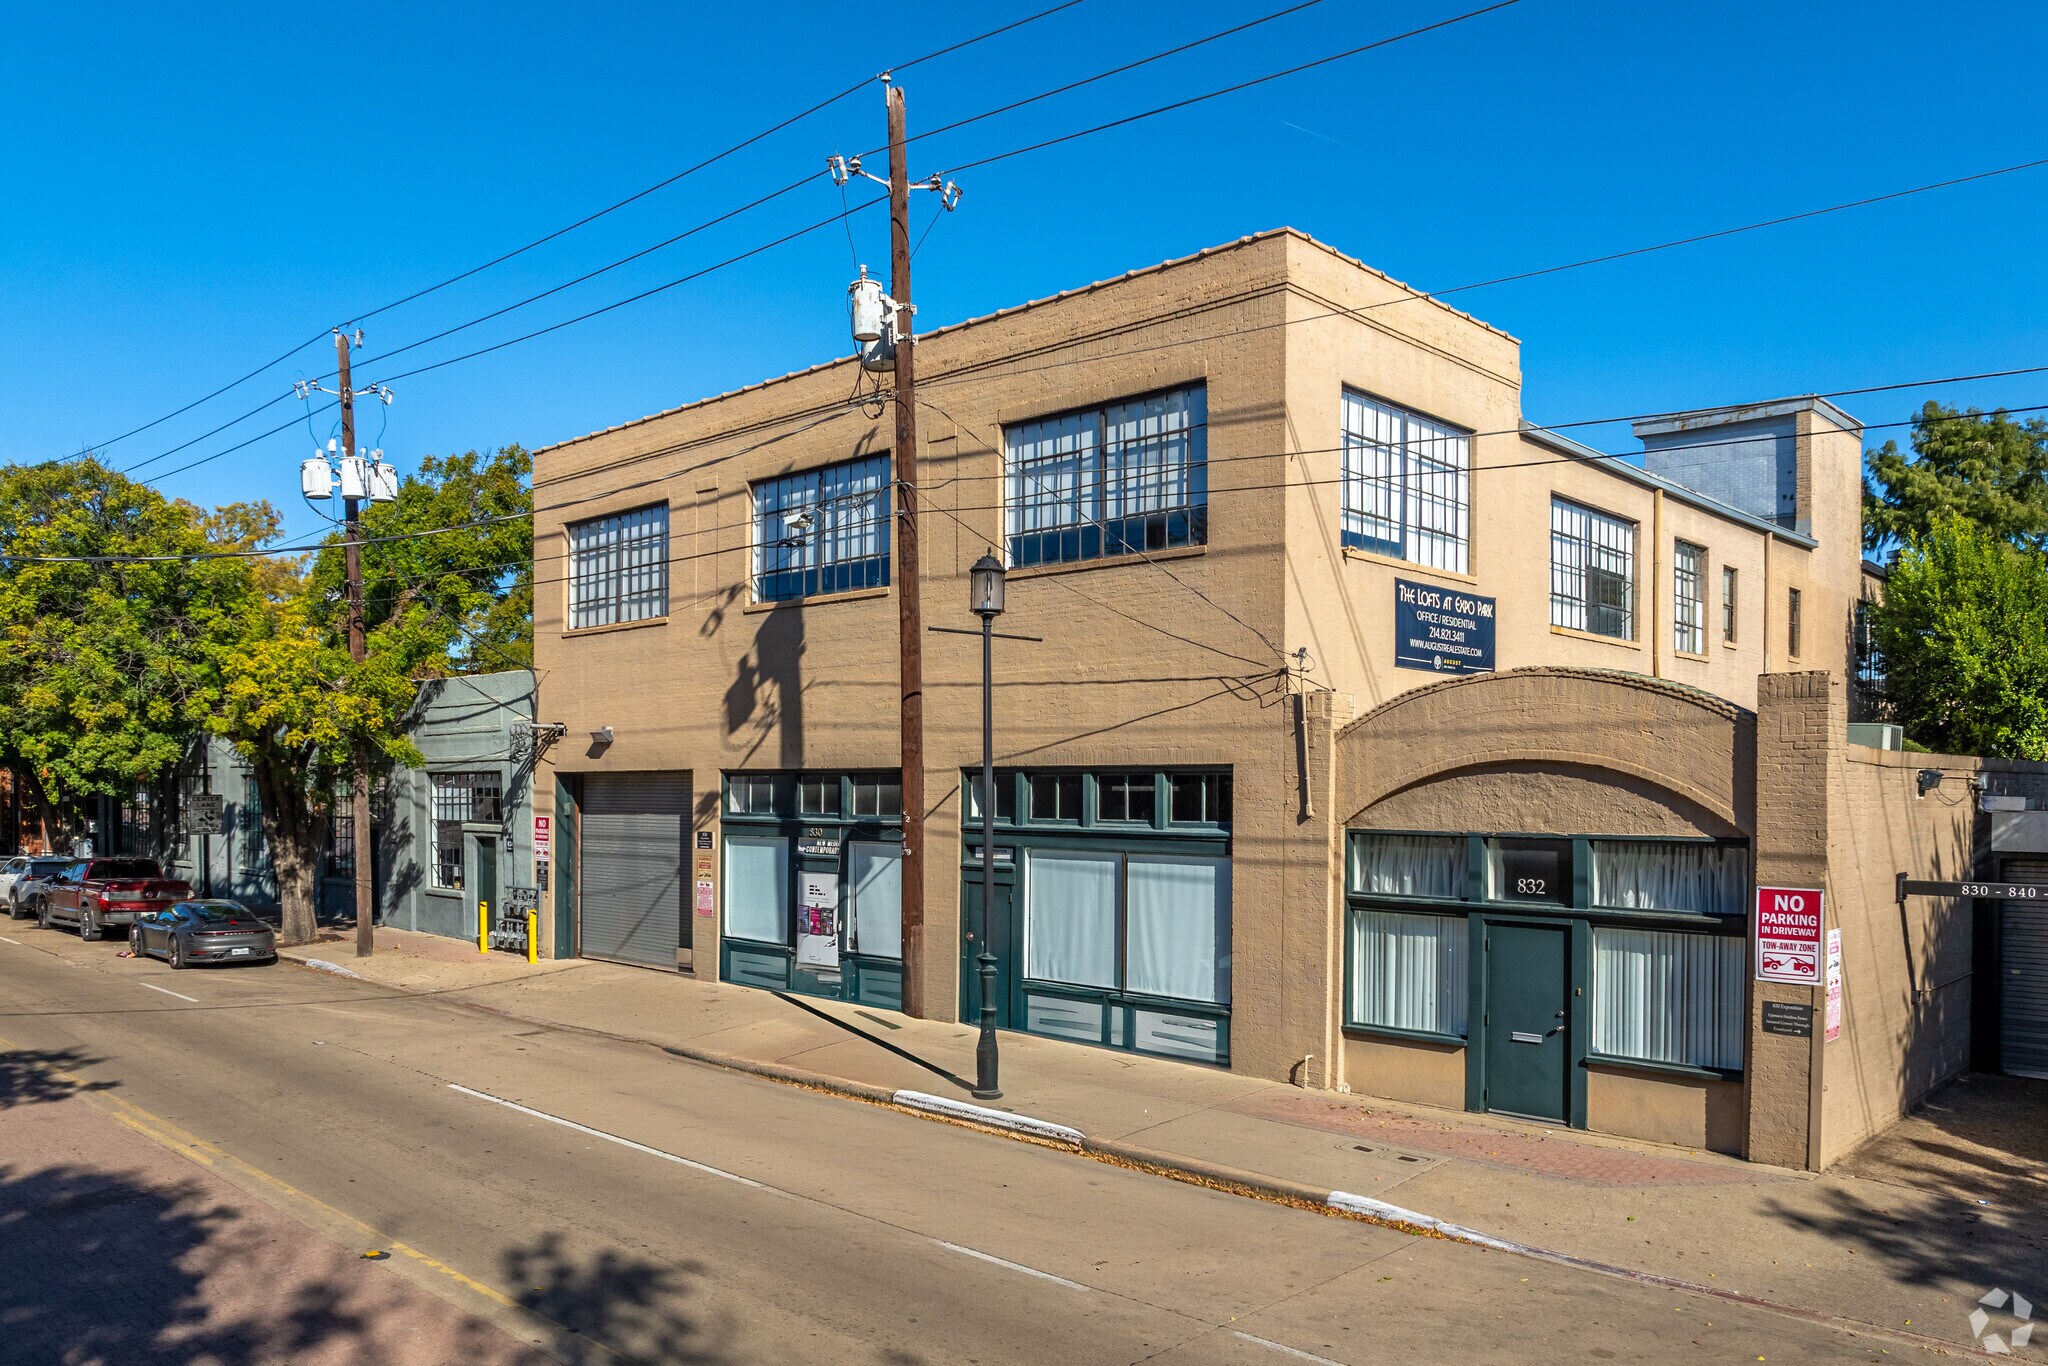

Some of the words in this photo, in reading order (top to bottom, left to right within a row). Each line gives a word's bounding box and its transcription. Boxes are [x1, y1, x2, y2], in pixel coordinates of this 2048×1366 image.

[1399, 584, 1415, 604] THE
[1418, 589, 1440, 608] LOFTS
[1443, 597, 1452, 610] AT
[1455, 597, 1475, 615] EXPO
[1478, 601, 1493, 618] PARK
[1416, 611, 1438, 624] OFFICE
[1442, 616, 1477, 630] RESIDENTIAL
[1429, 626, 1464, 642] 214.821.3411
[1410, 638, 1482, 657] WWW.AUGUSTREALESTATE.COM
[538, 820, 546, 828] NO
[810, 828, 822, 836] 830
[1518, 878, 1545, 894] 832
[1962, 885, 1988, 895] 830
[2008, 887, 2036, 898] 840
[1774, 894, 1804, 912] NO
[1762, 912, 1817, 926] PARKING
[1762, 926, 1770, 934] IN
[1772, 926, 1816, 936] DRIVEWAY
[1762, 941, 1797, 951] TOW-AWAY
[1799, 944, 1816, 952] ZONE
